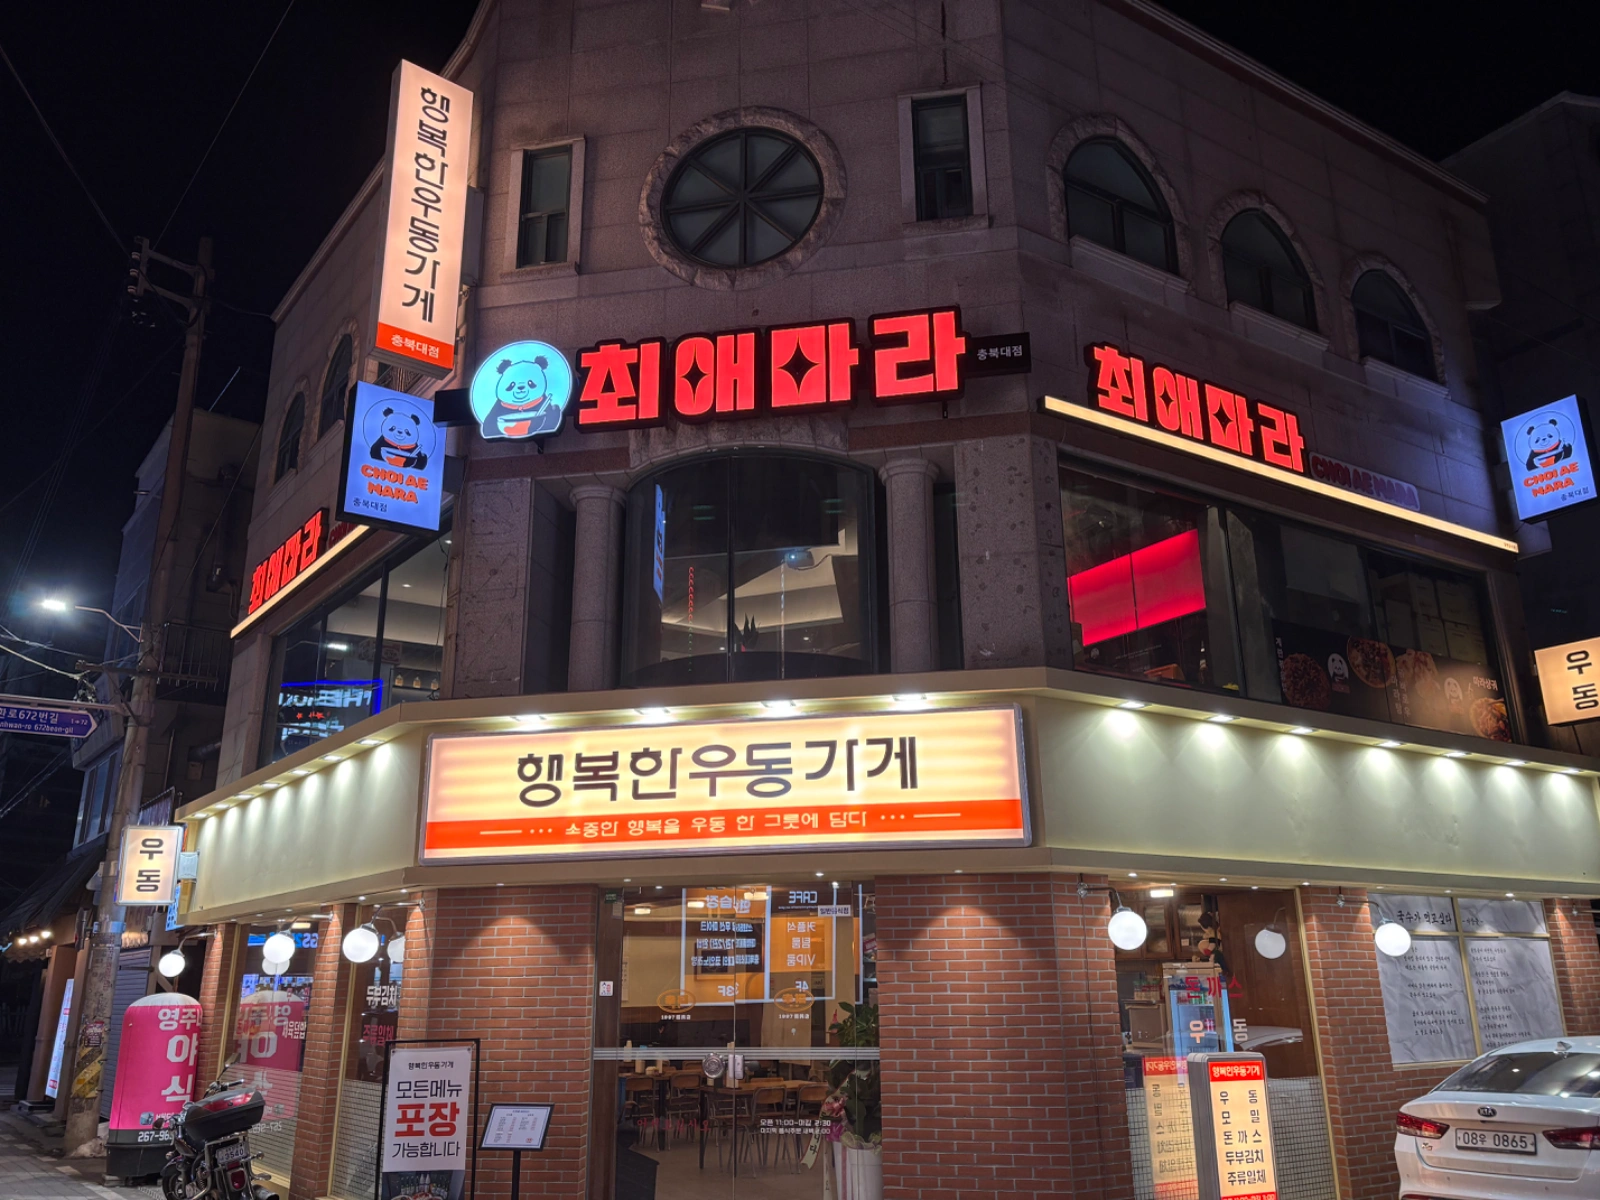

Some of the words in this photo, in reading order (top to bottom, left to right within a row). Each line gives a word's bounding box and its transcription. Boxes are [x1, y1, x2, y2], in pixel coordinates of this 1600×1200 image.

[401, 86, 451, 324] 행복한우동가게
[391, 333, 440, 359] 충북대점
[977, 344, 1024, 362] 충북대점
[579, 310, 966, 425] 최애마라
[1093, 346, 1305, 472] 최애마라
[353, 498, 388, 512] 충북대점
[1566, 650, 1600, 710] 우동
[517, 736, 918, 808] 행복한우동가게
[565, 820, 619, 839] 소중한
[628, 818, 680, 836] 행복을
[690, 816, 726, 833] 우동
[737, 815, 755, 832] 한
[763, 812, 819, 830] 그릇에
[829, 810, 868, 828] 담다
[136, 838, 164, 892] 우동
[396, 1079, 462, 1099] 모든메뉴
[394, 1101, 460, 1137] 포장
[392, 1141, 460, 1158] 가능합니다
[1463, 1132, 1487, 1145] 08우
[1493, 1134, 1528, 1149] 0865
[1225, 1149, 1264, 1166] 두부김치
[1227, 1169, 1267, 1186] 주류일체
